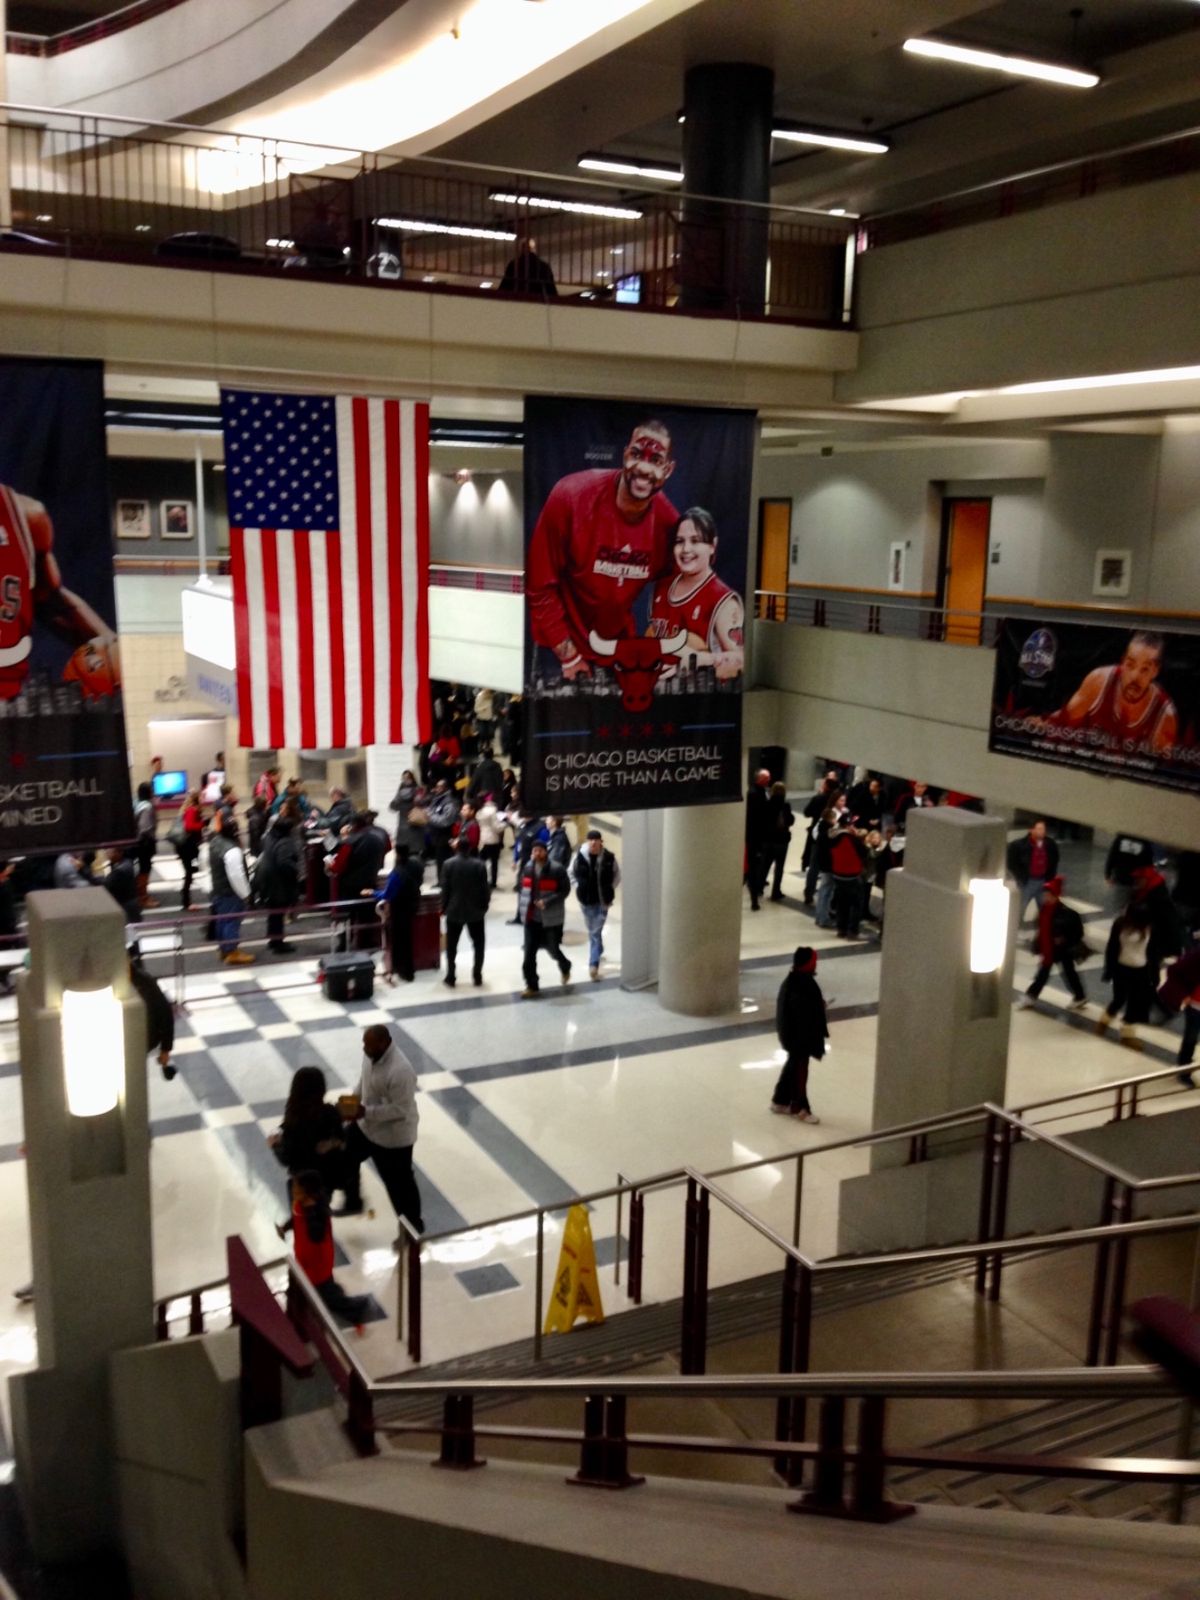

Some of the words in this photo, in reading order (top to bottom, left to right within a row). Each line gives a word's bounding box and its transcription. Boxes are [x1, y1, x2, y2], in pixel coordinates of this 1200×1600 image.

[994, 715, 1046, 736] CHICAGO
[1048, 726, 1120, 749] BASKETBALL
[1123, 737, 1135, 752] IS
[544, 750, 623, 771] CHICAGO
[625, 746, 722, 766] BASKETBALL
[545, 774, 560, 792] IS
[563, 771, 611, 790] MORE
[614, 769, 658, 786] THAN
[660, 769, 672, 783] A
[674, 765, 721, 782] GAME
